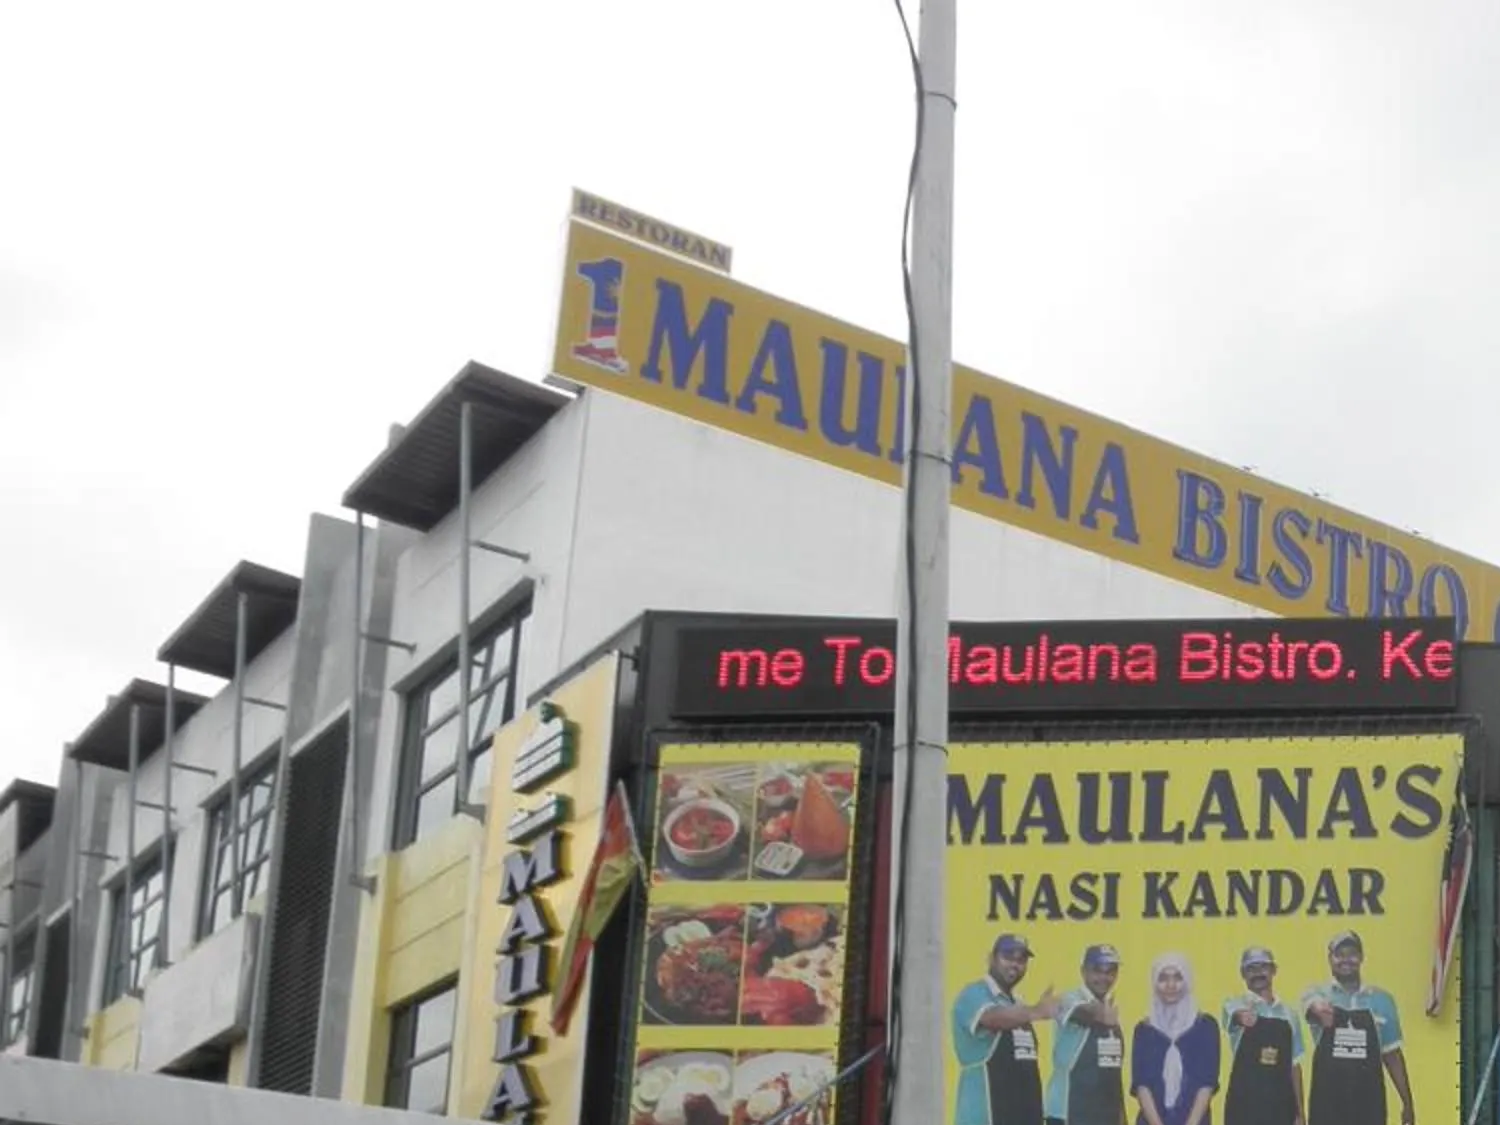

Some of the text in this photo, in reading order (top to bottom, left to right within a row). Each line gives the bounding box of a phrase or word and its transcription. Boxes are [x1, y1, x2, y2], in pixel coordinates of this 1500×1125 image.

[579, 194, 727, 266] RESTORAN
[1172, 468, 1470, 640] BISTRO
[718, 644, 804, 688] me
[825, 635, 896, 687] To
[1179, 631, 1357, 681] Bistro.
[1382, 629, 1454, 679] Ke
[946, 764, 1443, 846] MAULANA'S
[986, 868, 1386, 921] NASI KANDAR
